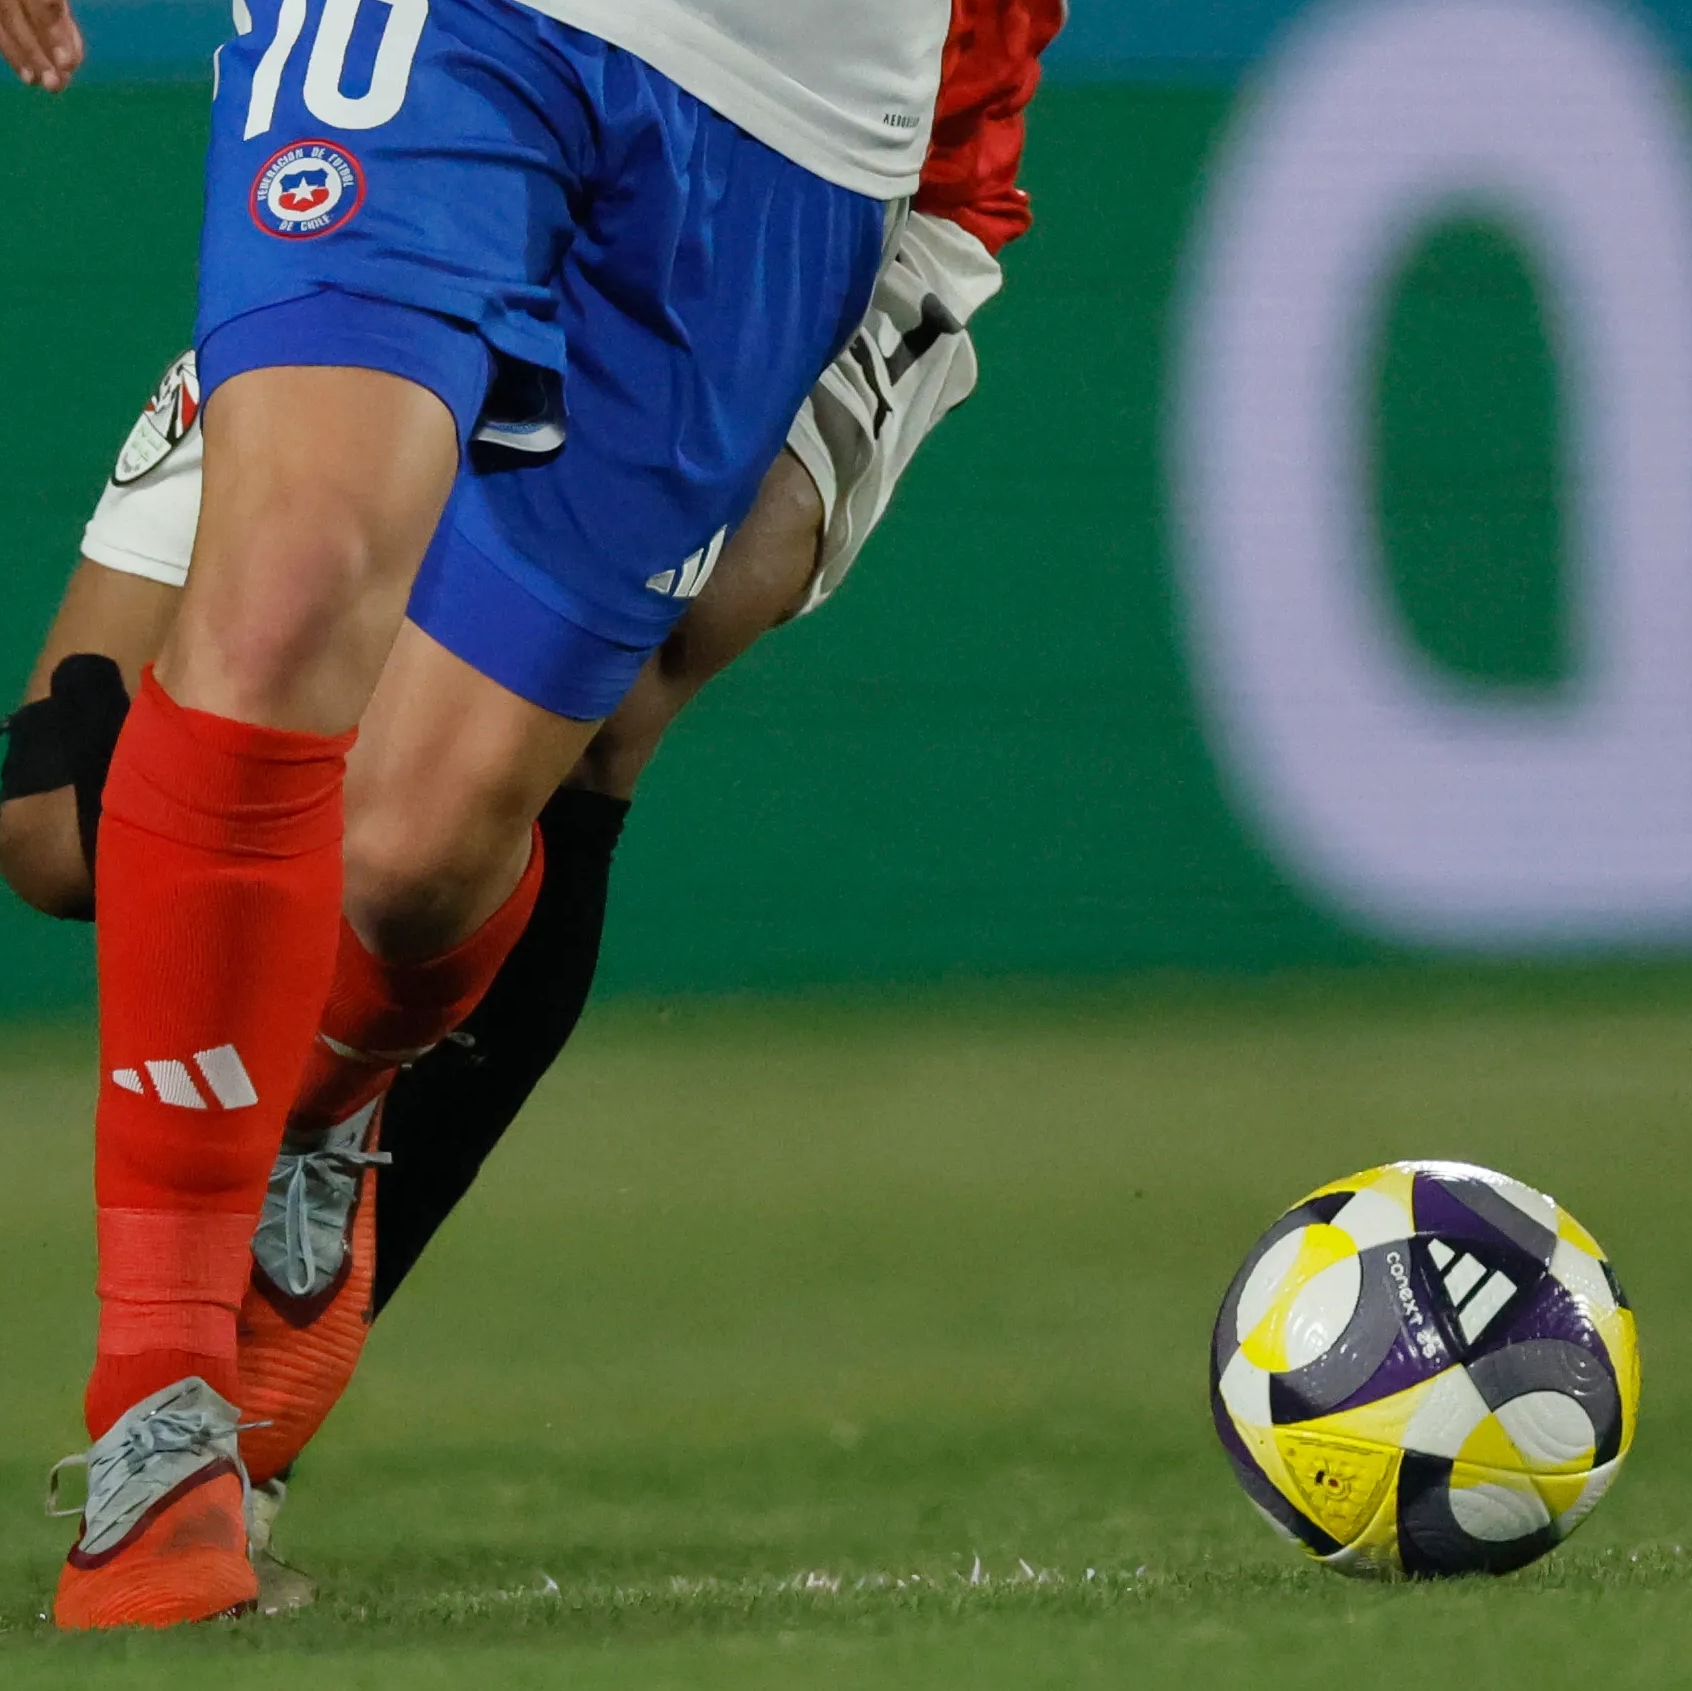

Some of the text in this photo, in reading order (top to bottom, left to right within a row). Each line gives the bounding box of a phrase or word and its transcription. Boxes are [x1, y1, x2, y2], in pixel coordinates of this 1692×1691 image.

[257, 148, 304, 202] FEDERACION
[311, 146, 327, 160] DE
[278, 214, 332, 232] DE CHILE
